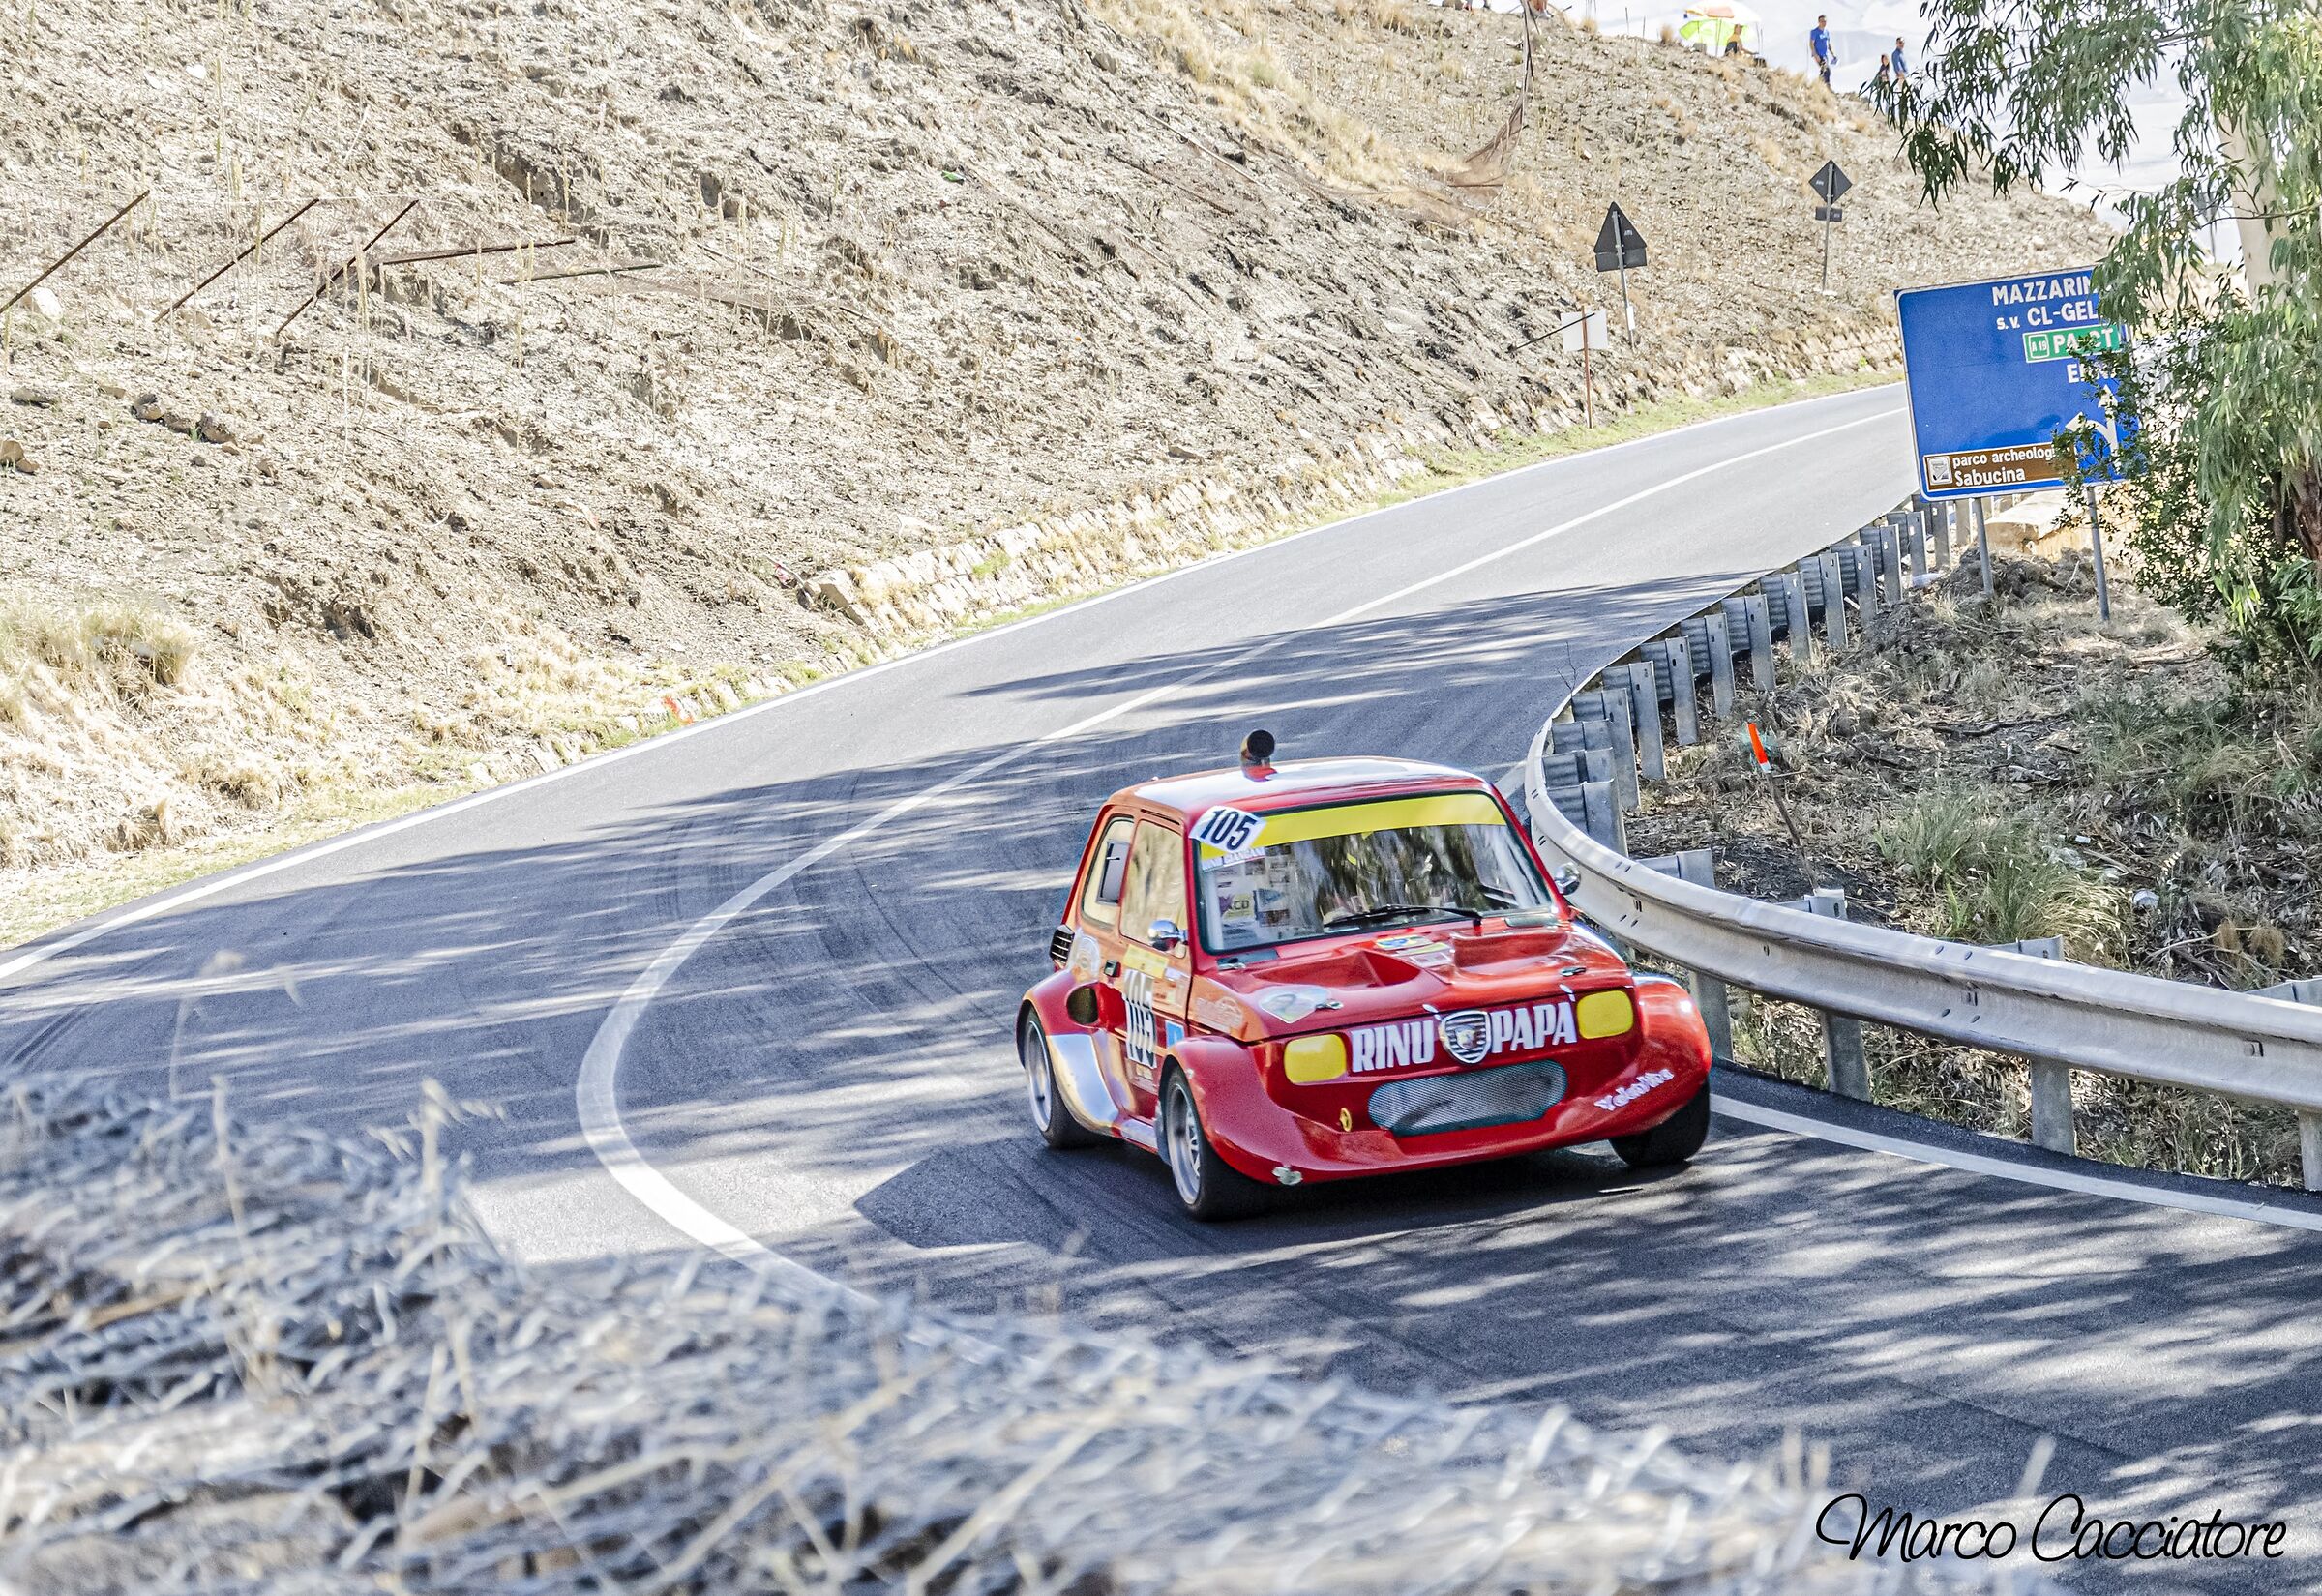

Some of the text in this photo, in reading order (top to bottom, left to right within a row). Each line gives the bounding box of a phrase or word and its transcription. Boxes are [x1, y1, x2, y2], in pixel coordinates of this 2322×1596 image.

[1992, 276, 2099, 306] MAZZARIN
[2027, 300, 2099, 326] CL-GEL
[1952, 454, 1987, 469] parco
[1954, 466, 2026, 487] Sabucina
[1200, 809, 1258, 851] 105
